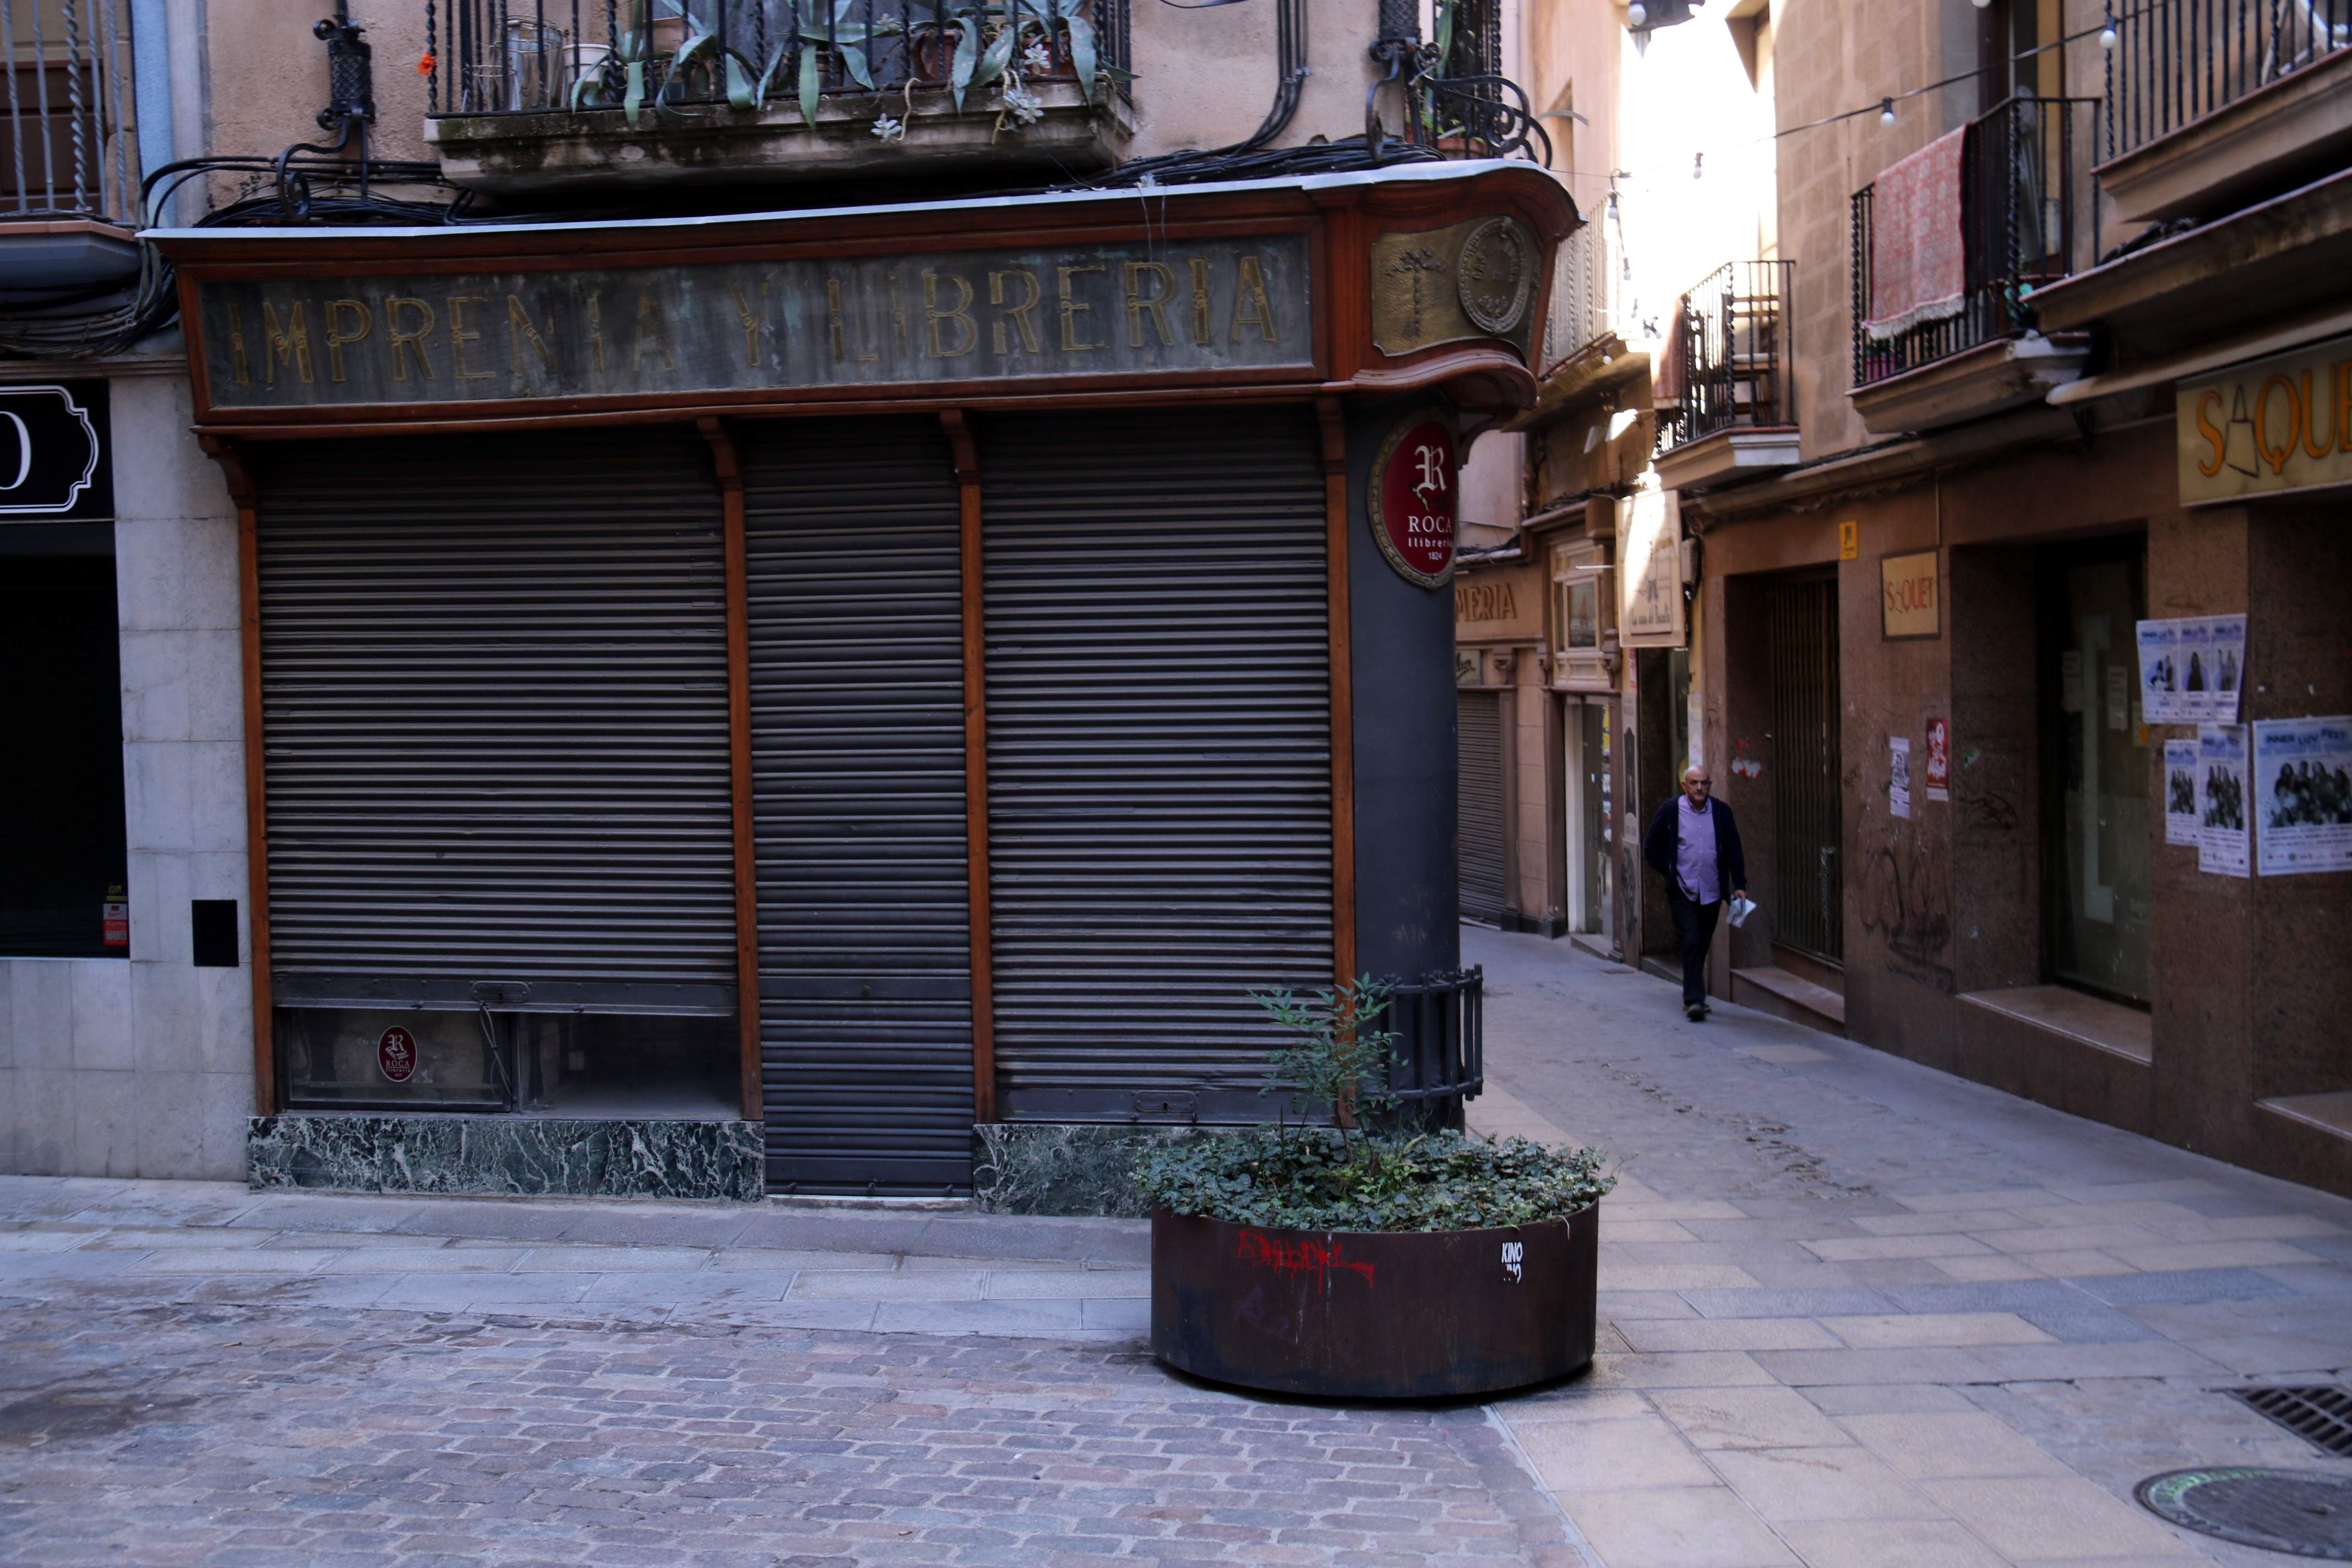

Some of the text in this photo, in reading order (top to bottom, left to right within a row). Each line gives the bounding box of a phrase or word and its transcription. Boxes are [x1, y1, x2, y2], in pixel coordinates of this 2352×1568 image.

[728, 281, 768, 367] Y
[827, 256, 1277, 361] LIBRERIA
[1414, 444, 1448, 493] R
[1408, 516, 1453, 532] ROCA
[1428, 551, 1443, 560] 1824
[388, 1034, 405, 1052] R
[1501, 1242, 1523, 1264] KINO
